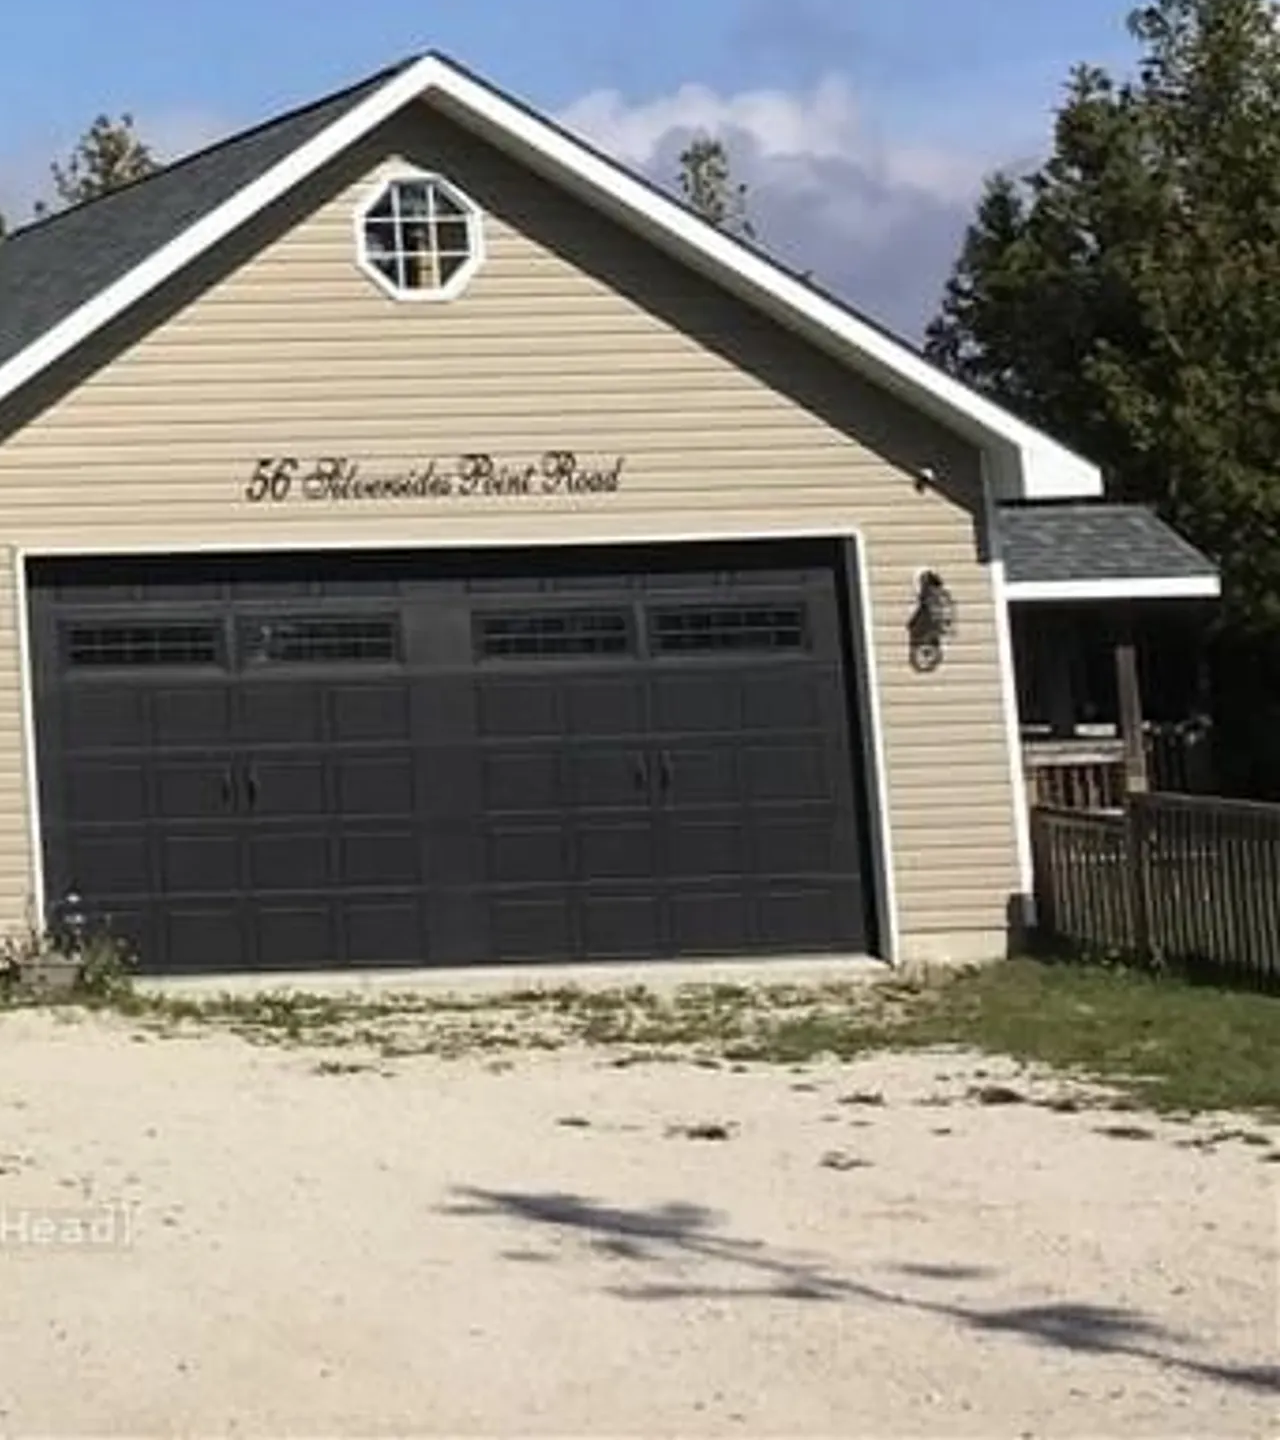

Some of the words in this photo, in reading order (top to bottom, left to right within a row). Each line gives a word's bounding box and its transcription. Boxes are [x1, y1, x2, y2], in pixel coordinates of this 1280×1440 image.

[245, 458, 298, 501] 56
[457, 453, 534, 496] Point
[541, 450, 627, 494] Road
